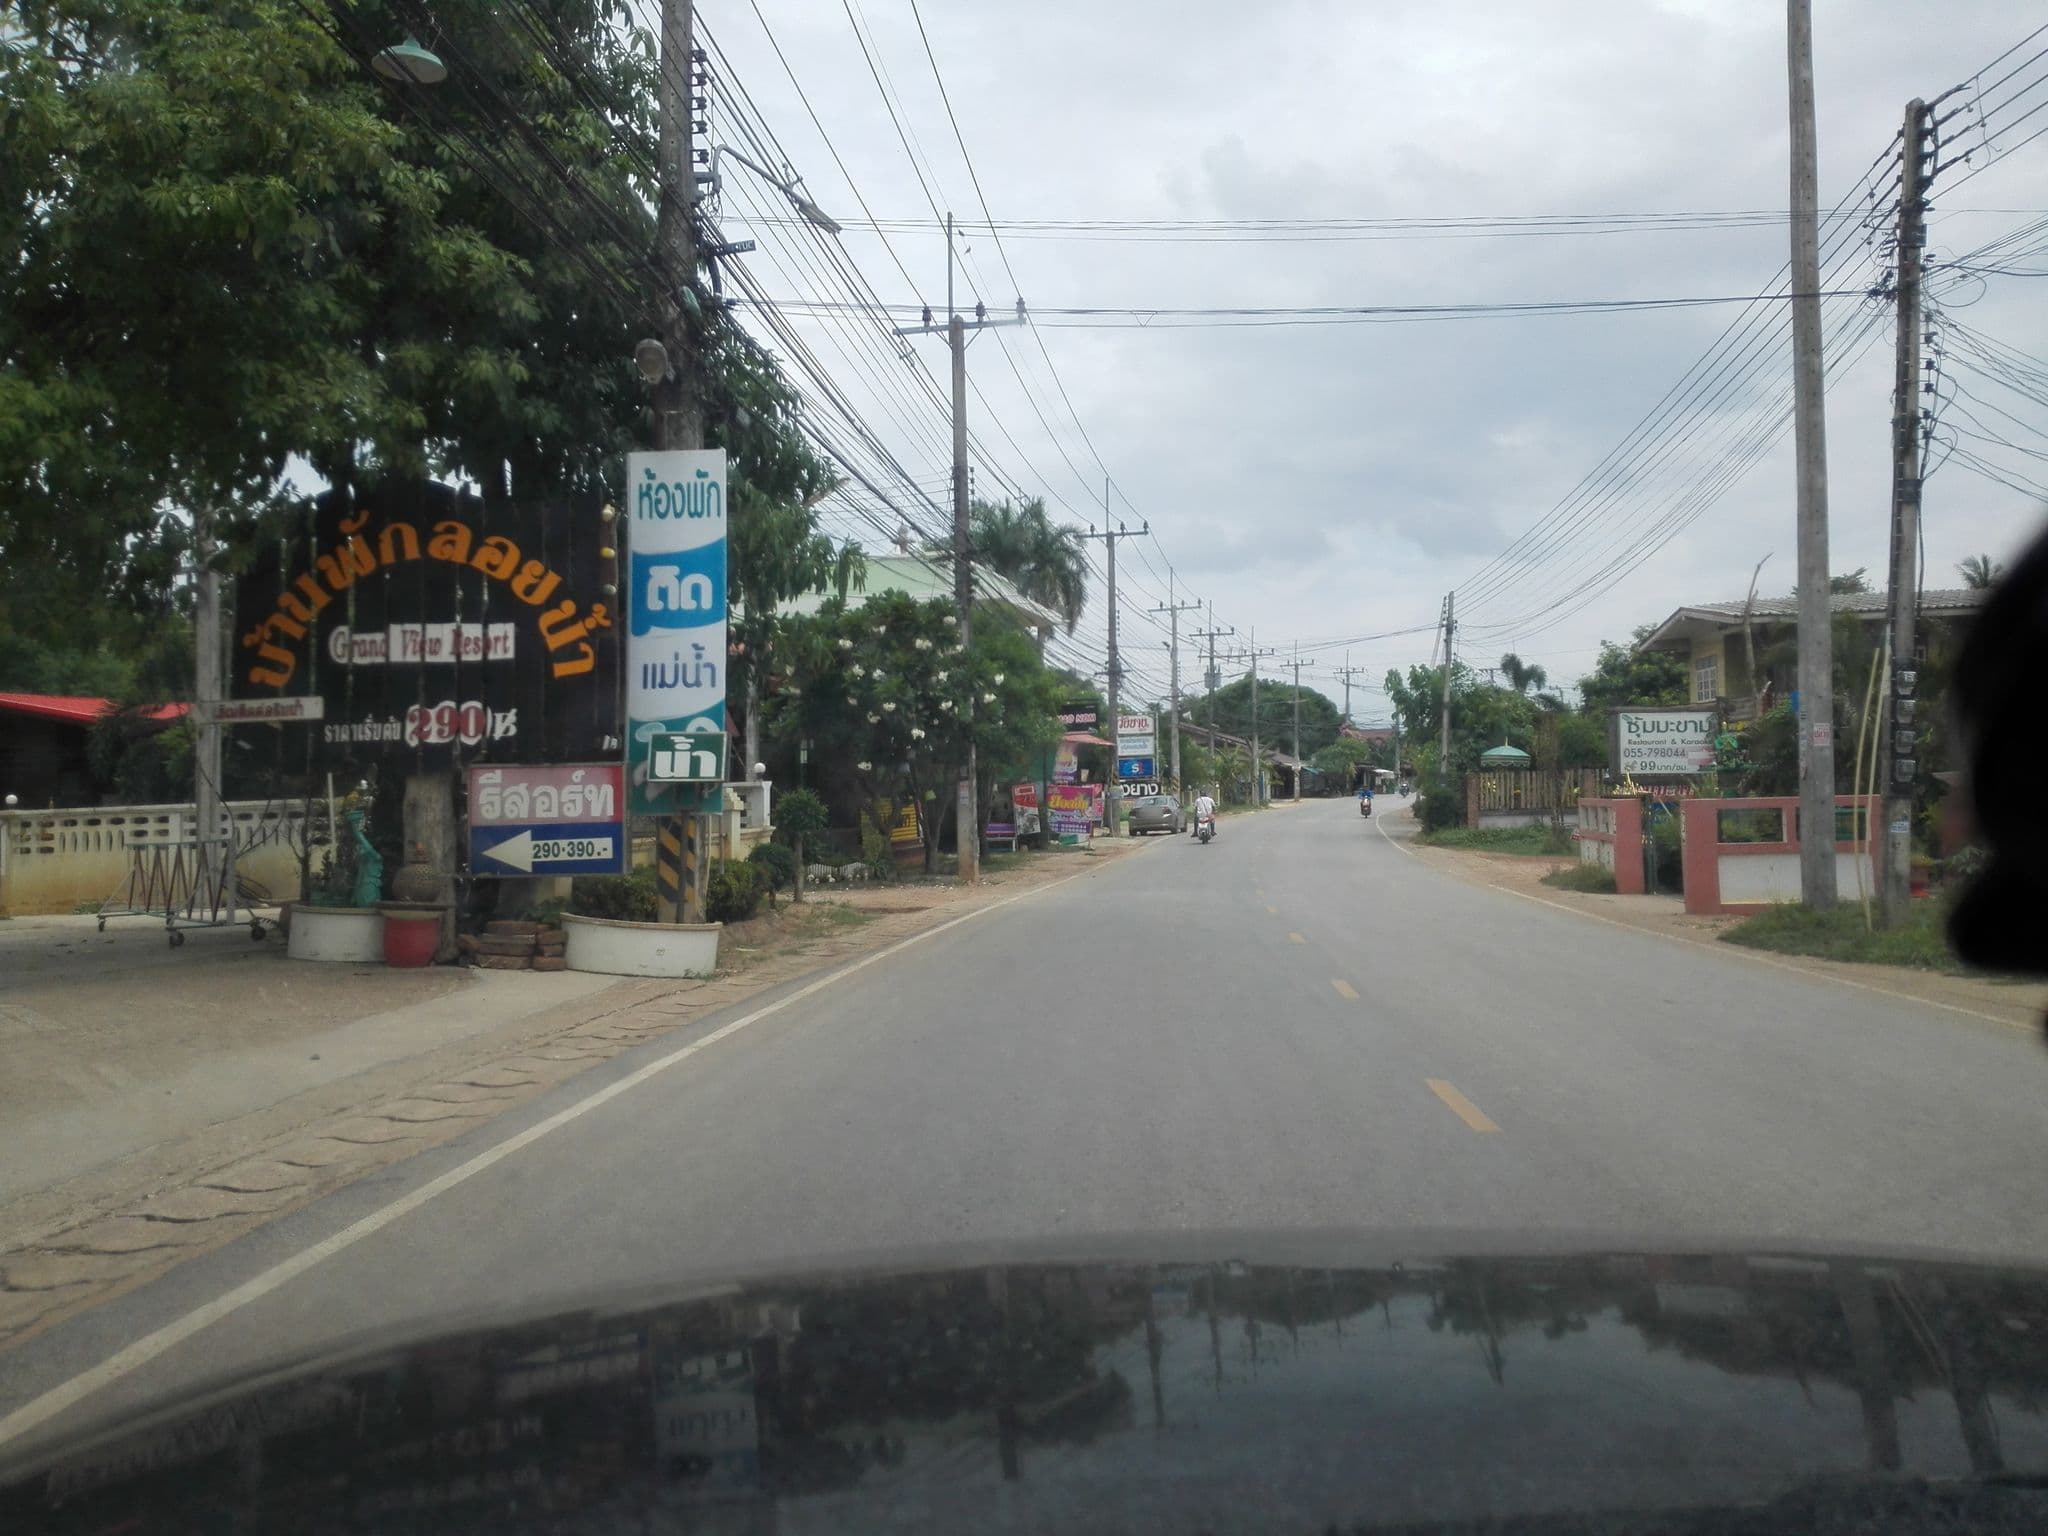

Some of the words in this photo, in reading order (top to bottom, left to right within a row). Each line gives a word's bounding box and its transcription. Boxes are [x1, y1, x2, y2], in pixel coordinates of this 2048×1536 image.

[638, 467, 721, 519] ห้องพัก
[243, 509, 612, 688] บ้านพักลอยน้ำ
[646, 565, 713, 611] ติด
[330, 629, 387, 661] Grand
[643, 643, 716, 689] แม่น้ำ
[406, 701, 488, 746] 290
[655, 736, 717, 778] น้ำ
[478, 769, 614, 819] รีสอร์ท
